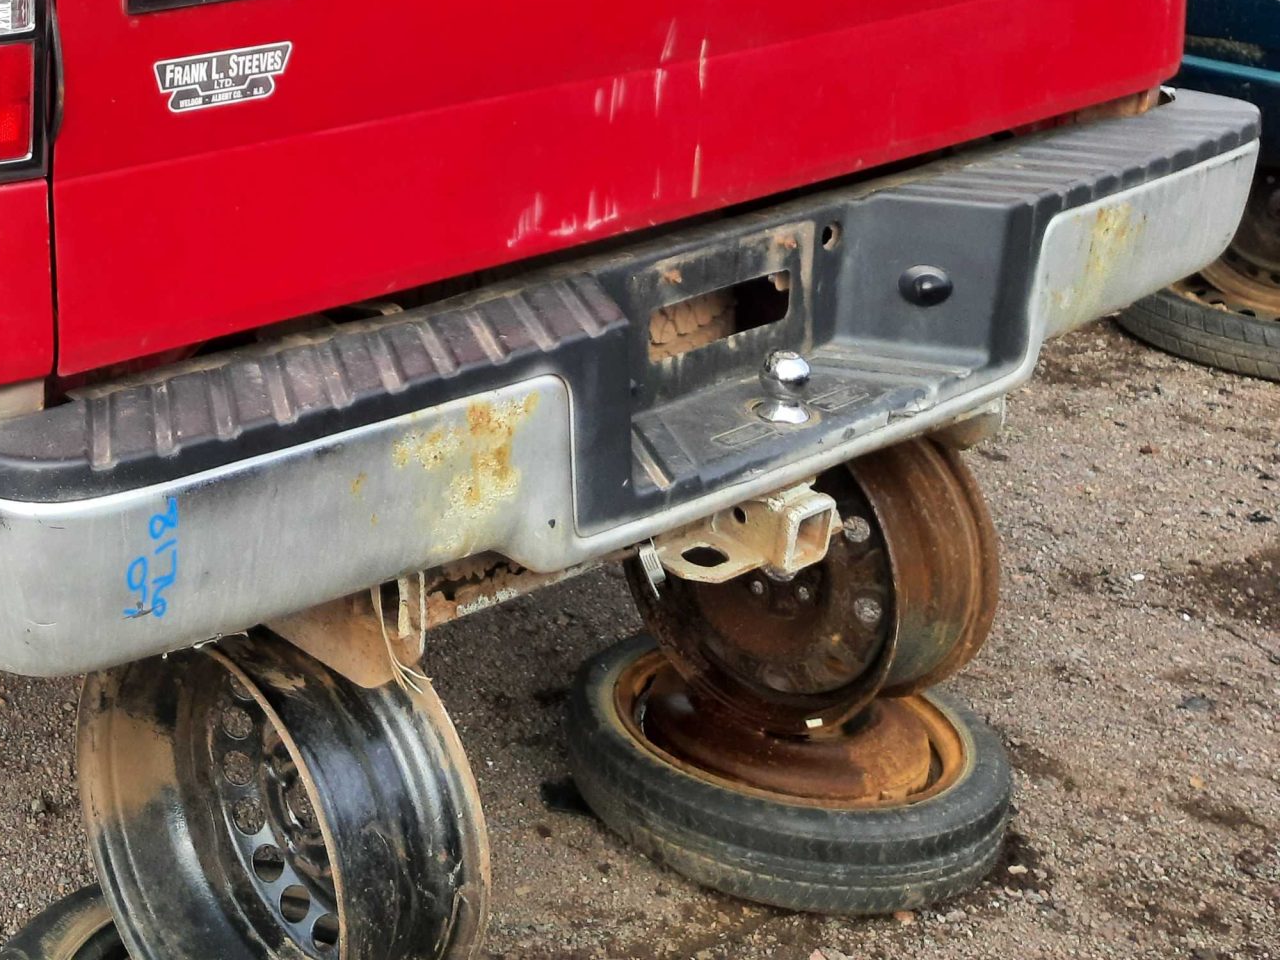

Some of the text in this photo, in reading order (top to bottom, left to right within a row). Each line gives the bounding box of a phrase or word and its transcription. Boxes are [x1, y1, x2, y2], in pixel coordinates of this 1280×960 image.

[165, 50, 283, 87] FRANK L. STEEVES
[214, 78, 236, 89] LTD.
